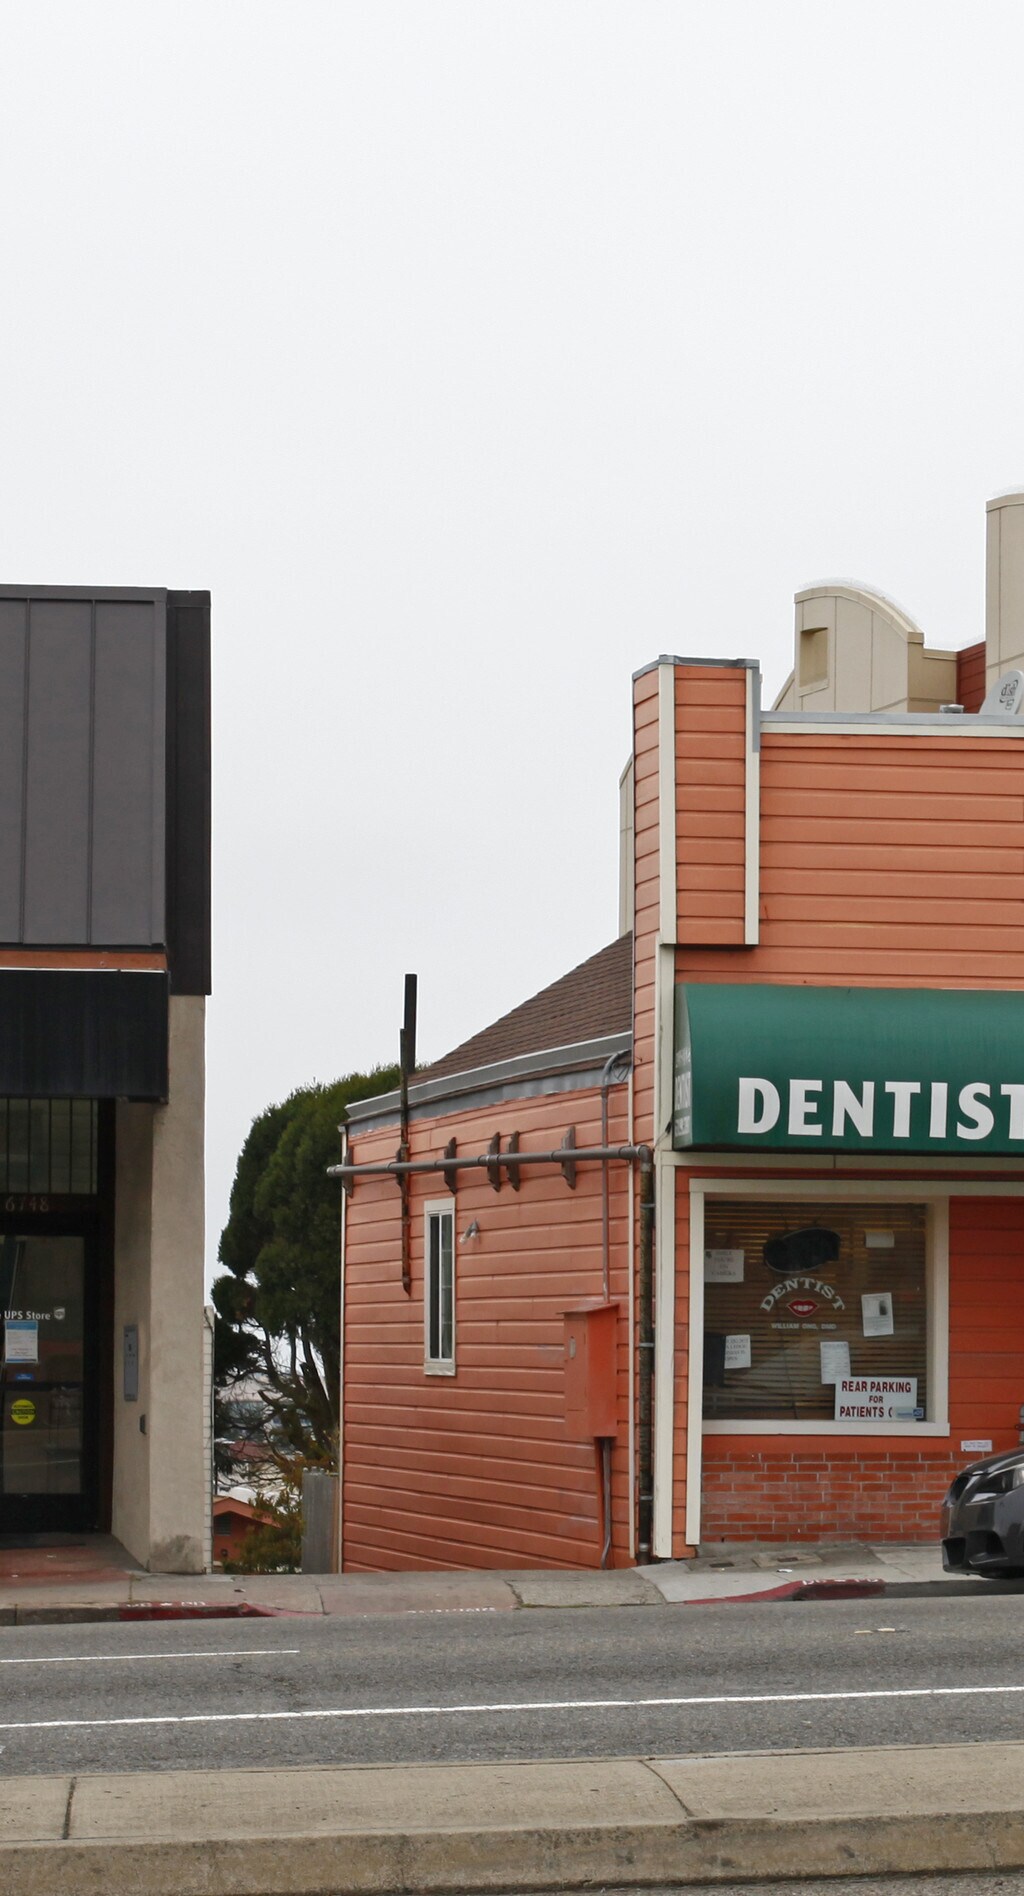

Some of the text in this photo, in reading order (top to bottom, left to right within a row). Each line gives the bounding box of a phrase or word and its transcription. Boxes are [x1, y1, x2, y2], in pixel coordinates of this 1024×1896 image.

[759, 1276, 846, 1313] DENTIST
[4, 1310, 23, 1320] UPS
[26, 1310, 51, 1320] Store
[841, 1380, 912, 1393] REAR PARKING
[868, 1395, 884, 1404] FOR
[839, 1406, 885, 1418] PATIENTS
